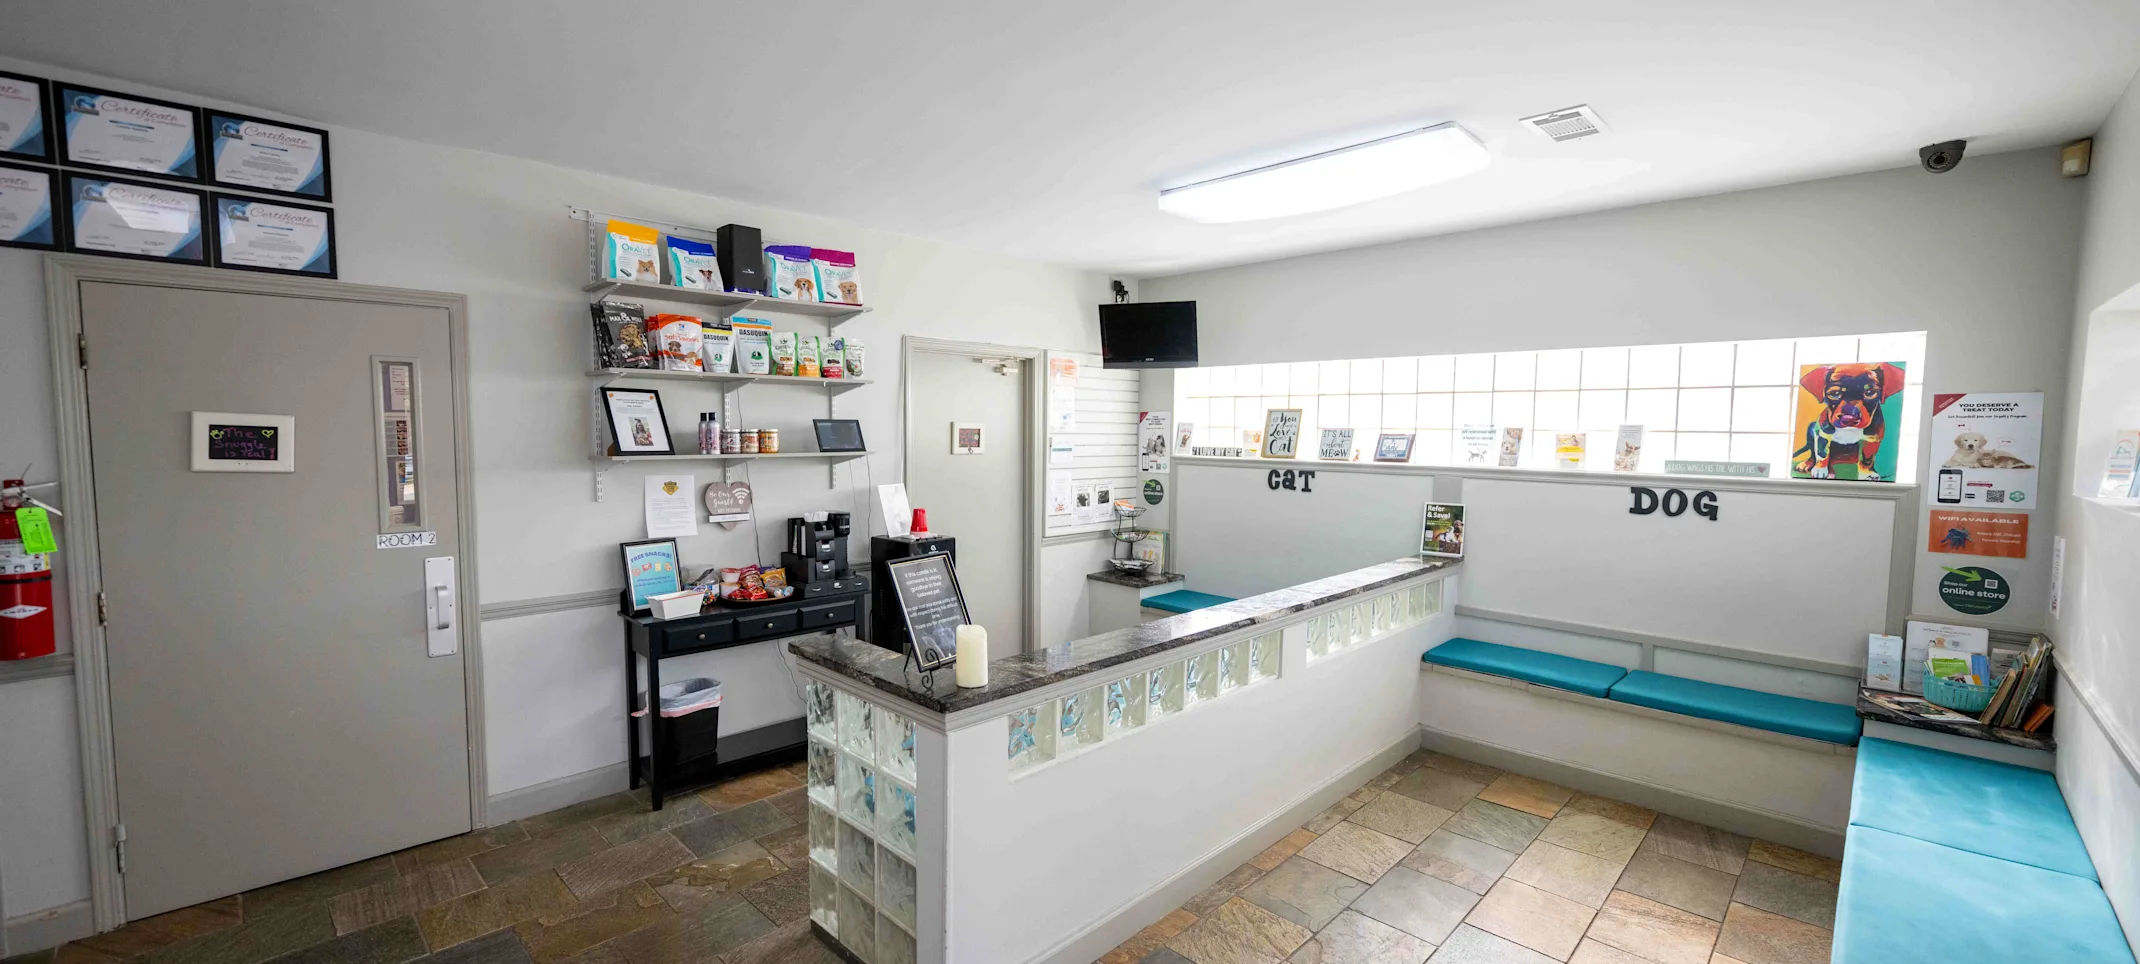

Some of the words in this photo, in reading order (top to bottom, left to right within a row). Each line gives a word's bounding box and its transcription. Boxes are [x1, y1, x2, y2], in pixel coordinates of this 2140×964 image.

[101, 100, 178, 121] Certificate
[244, 126, 308, 145] Certificate
[250, 207, 312, 224] Certificate
[739, 329, 768, 337] DASUQUIN
[223, 427, 257, 439] The
[1270, 423, 1291, 439] Love
[1323, 429, 1337, 438] IT'S
[1338, 430, 1351, 438] ALL
[213, 439, 266, 451] Snuggle
[1270, 436, 1295, 455] Cat
[1672, 463, 1686, 472] DOG
[1727, 465, 1745, 473] WITH
[1629, 486, 1719, 521] DOG
[379, 533, 423, 548] ROOM
[428, 533, 436, 544] 2
[631, 553, 644, 563] FREE
[1942, 587, 1975, 596] online
[1976, 590, 2006, 599] store
